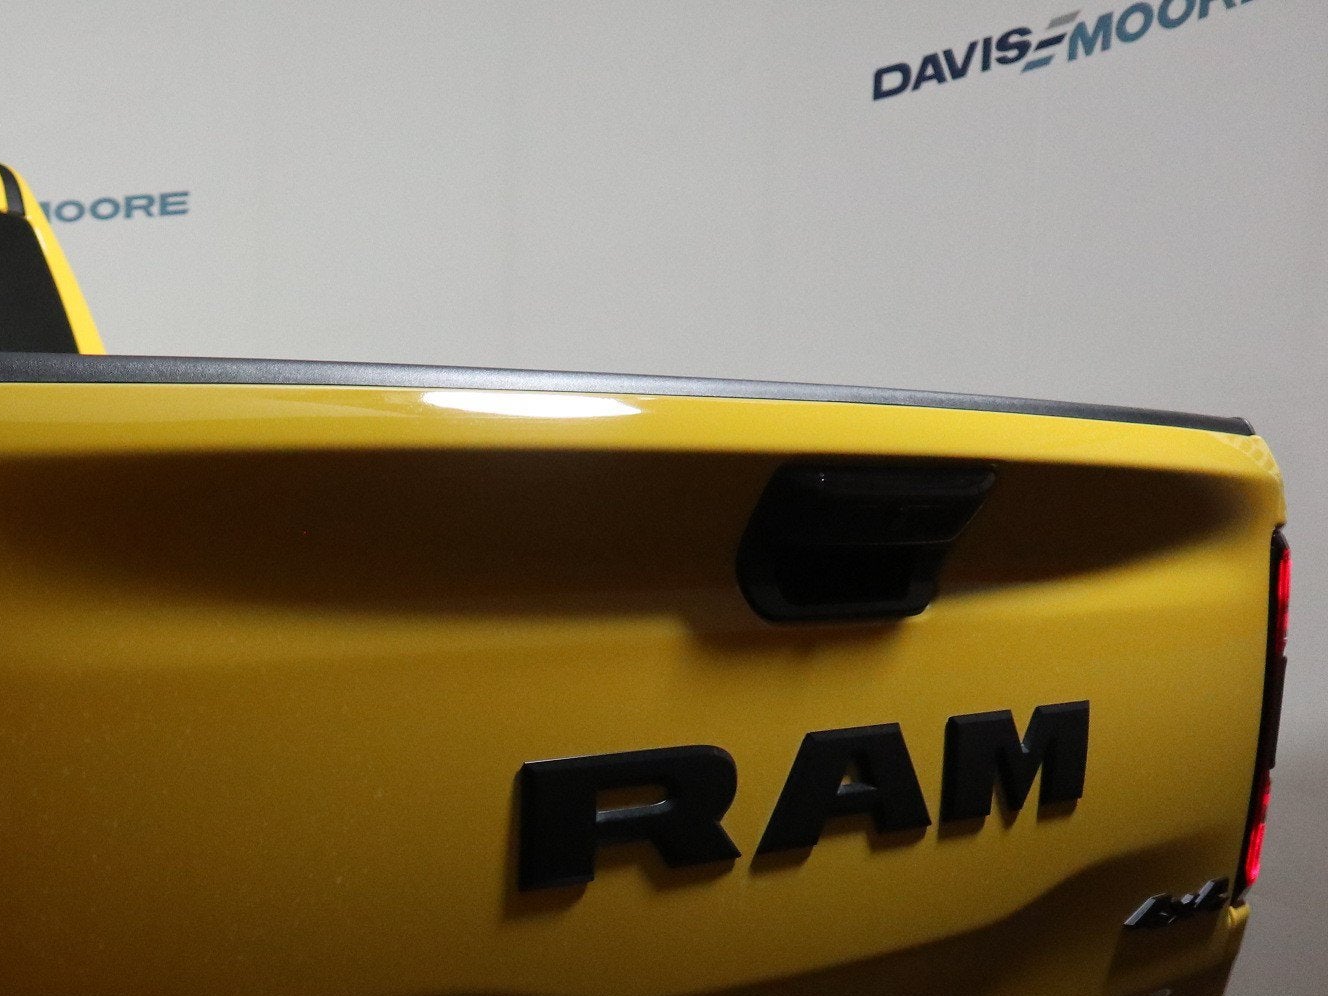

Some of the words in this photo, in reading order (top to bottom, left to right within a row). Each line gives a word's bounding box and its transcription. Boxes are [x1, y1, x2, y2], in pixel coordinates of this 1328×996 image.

[871, 26, 1033, 101] DAVIS
[1067, 0, 1256, 63] MOO
[518, 699, 1091, 894] RAM
